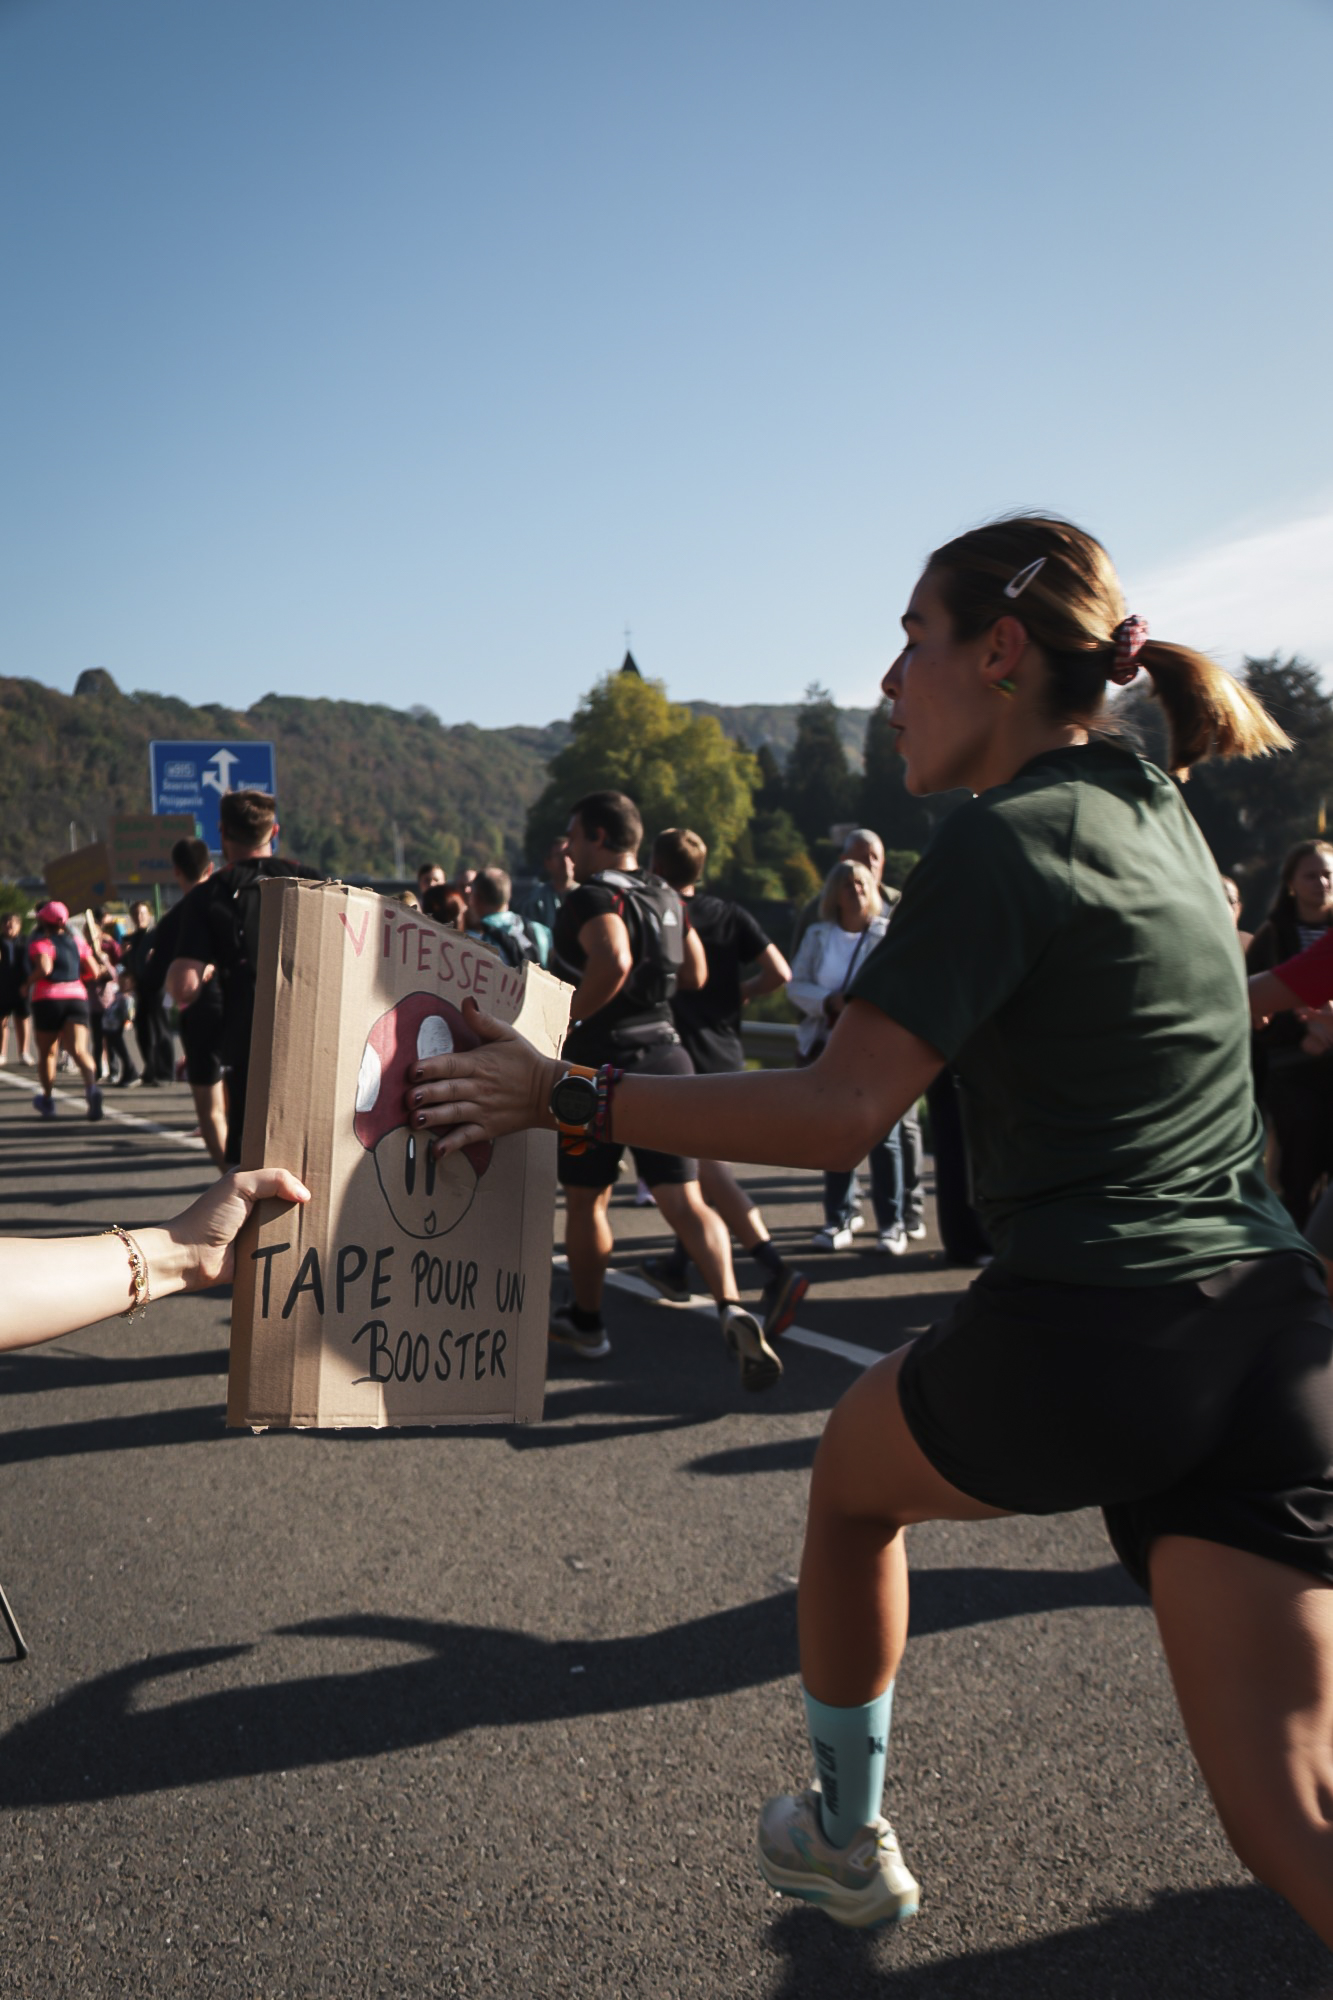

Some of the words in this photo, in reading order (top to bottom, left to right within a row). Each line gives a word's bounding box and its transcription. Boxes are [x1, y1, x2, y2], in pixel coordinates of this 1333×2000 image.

[251, 1242, 394, 1319] TAPE
[411, 1250, 478, 1310] POUR
[496, 1268, 526, 1313] UN
[351, 1319, 507, 1386] BOOSTER
